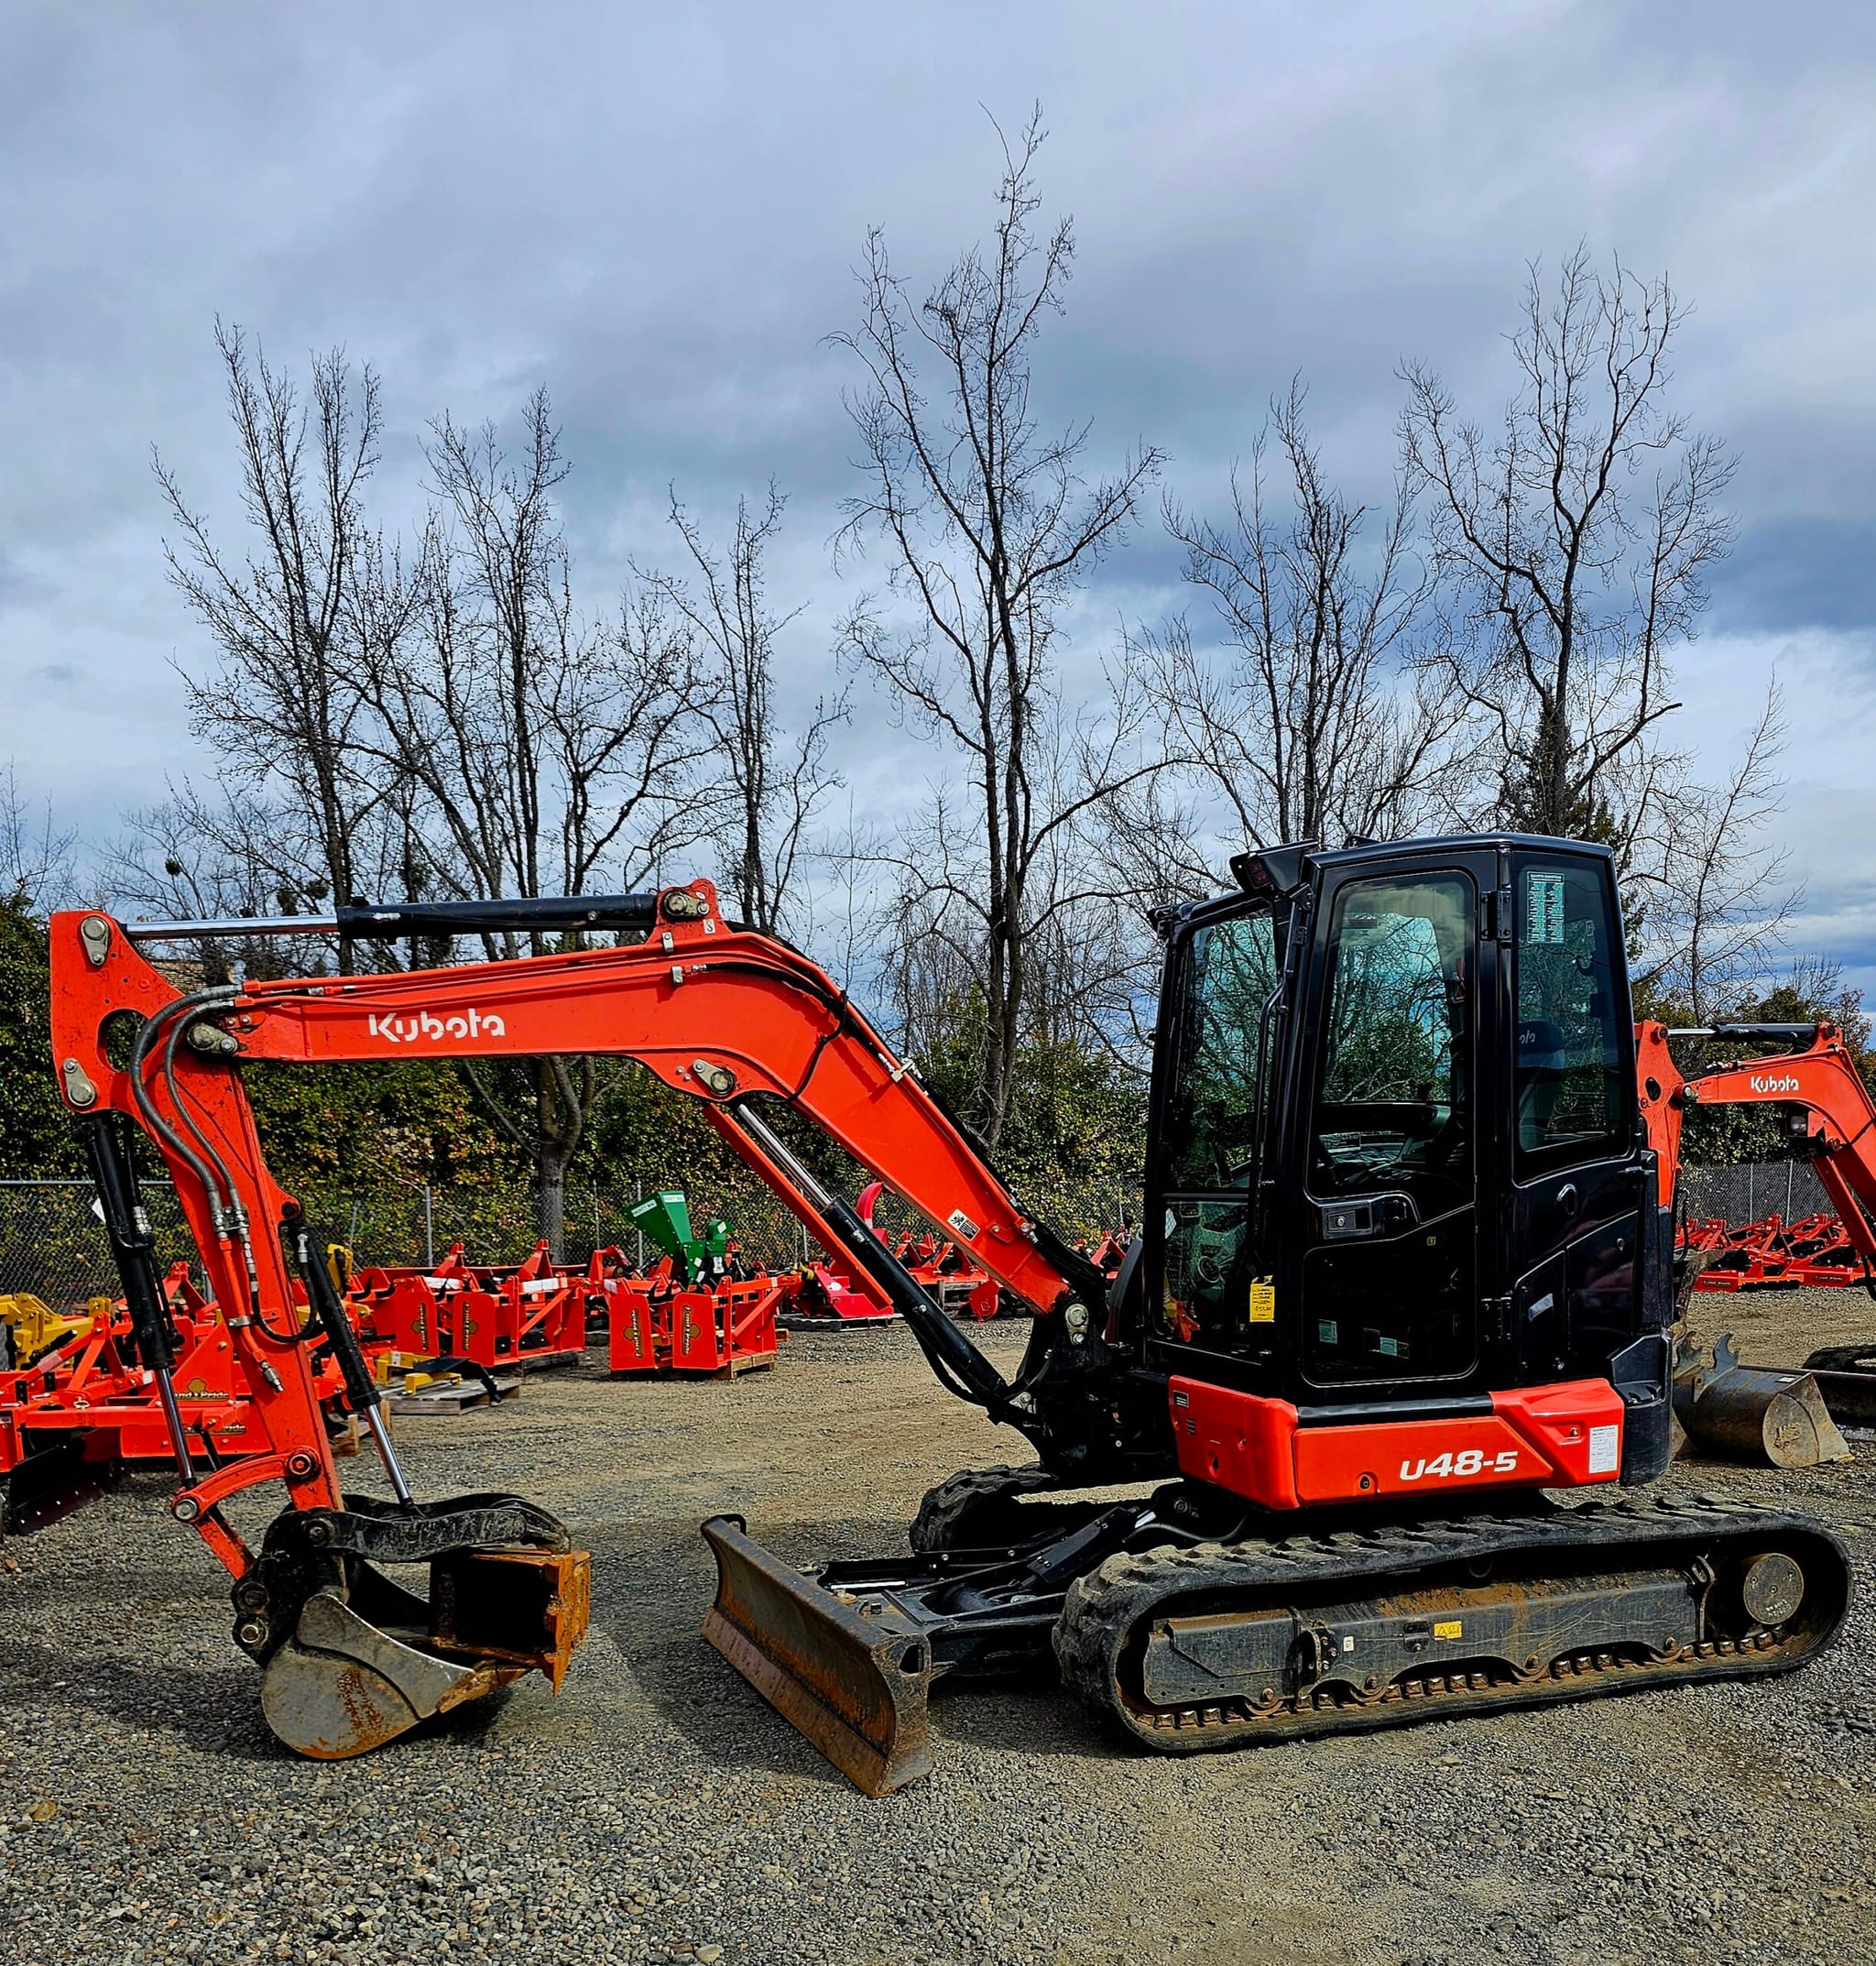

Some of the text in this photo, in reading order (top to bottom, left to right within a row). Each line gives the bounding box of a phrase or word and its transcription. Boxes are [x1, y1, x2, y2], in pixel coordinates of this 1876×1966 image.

[368, 1008, 506, 1043] Kubota
[1751, 1074, 1799, 1093] Kubota
[1399, 1449, 1519, 1480] U48-5
